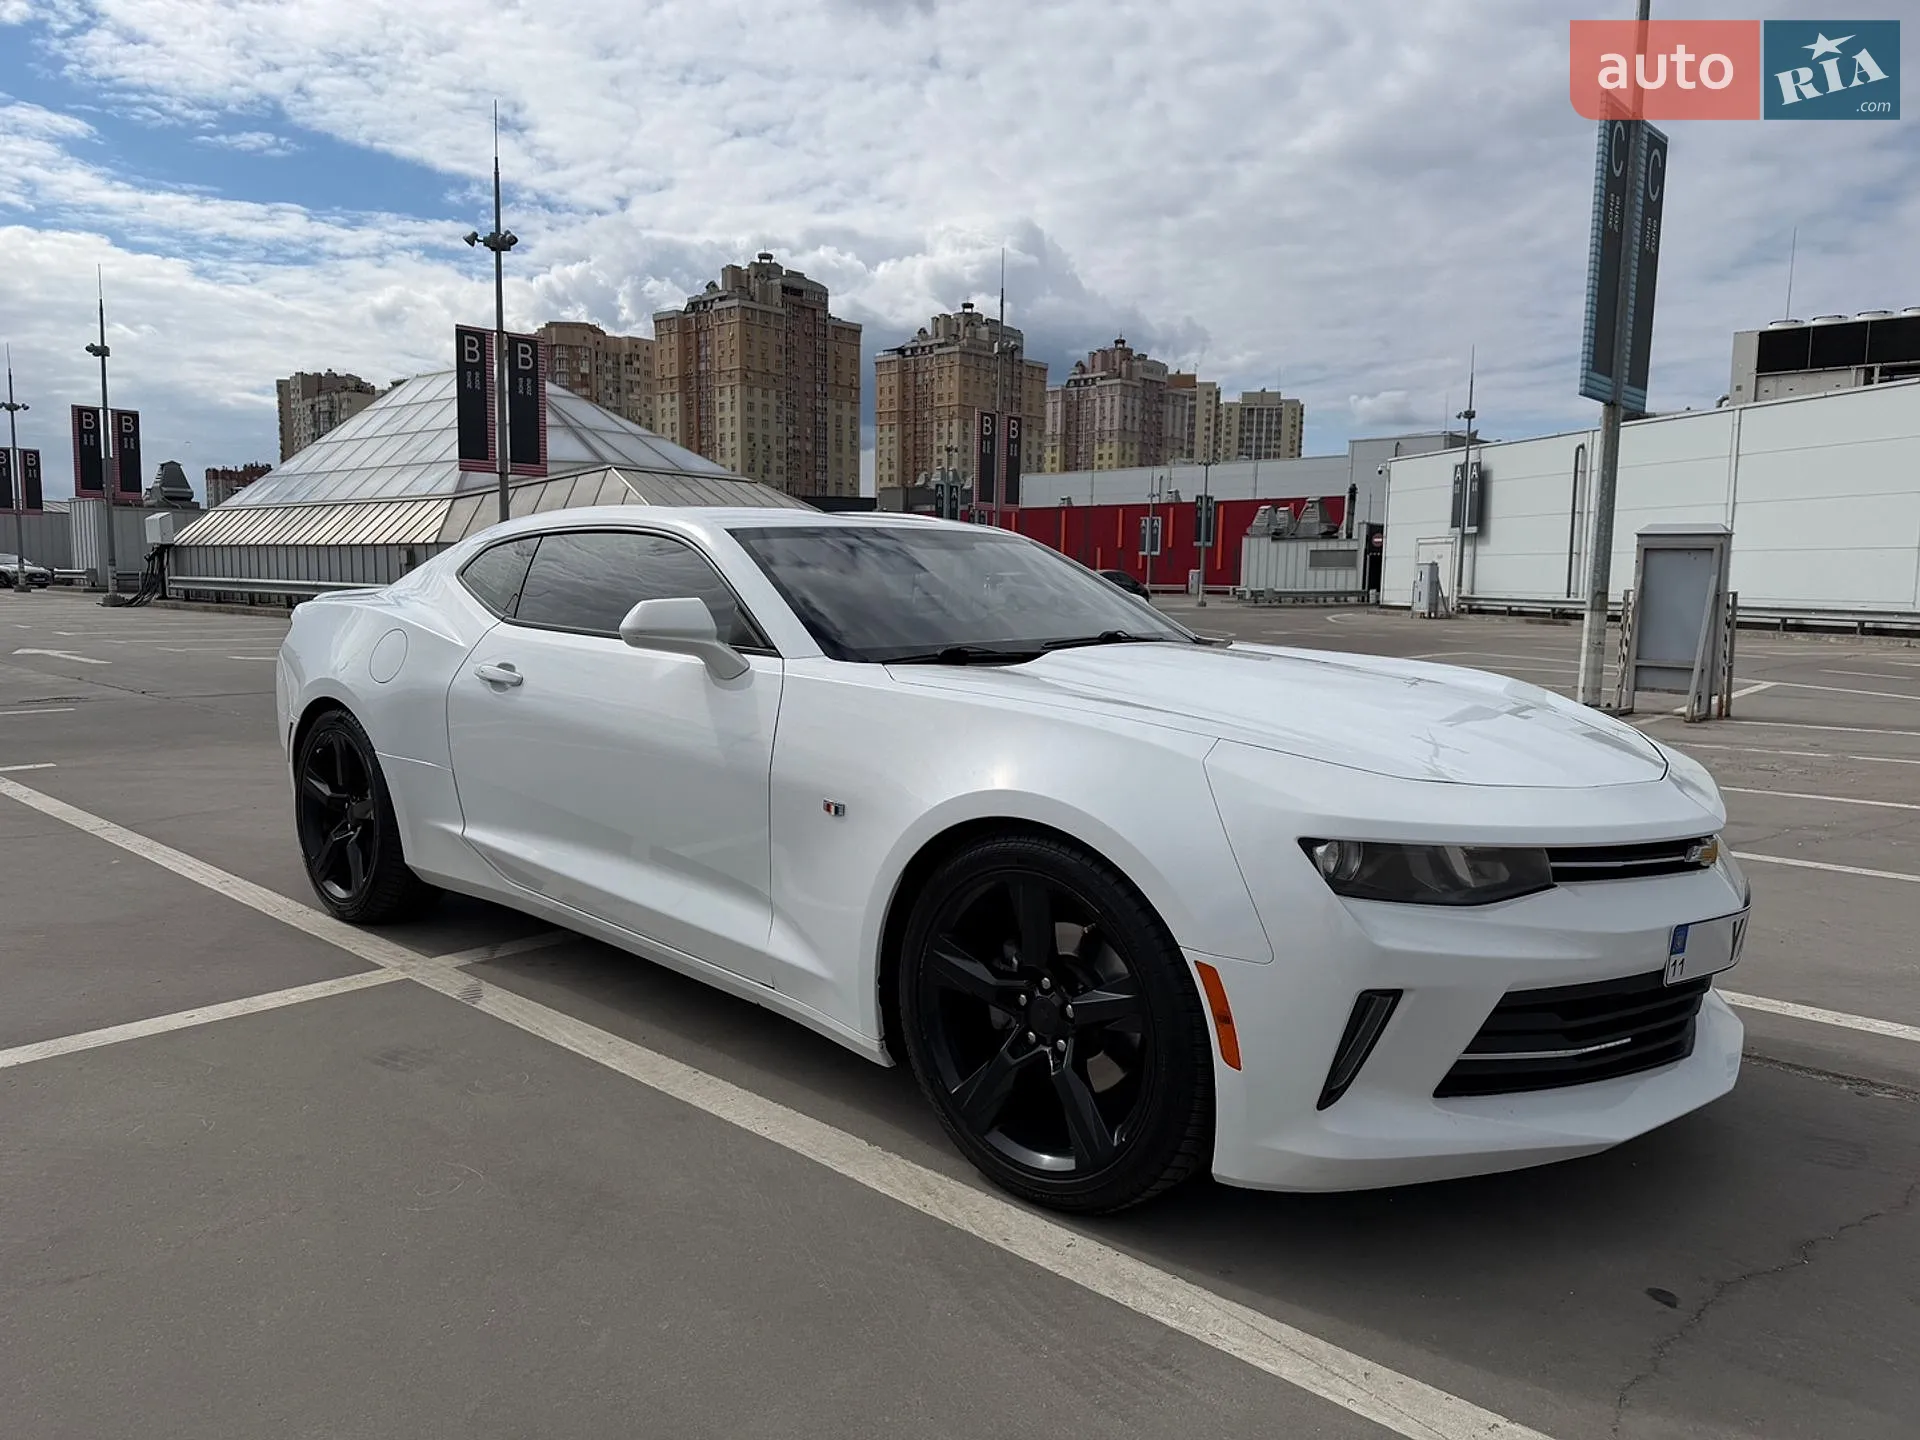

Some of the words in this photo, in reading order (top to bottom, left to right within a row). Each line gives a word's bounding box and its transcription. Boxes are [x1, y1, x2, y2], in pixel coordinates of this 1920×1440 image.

[1612, 121, 1625, 177] C
[1648, 149, 1661, 202] C
[464, 335, 480, 363] B
[517, 342, 534, 370] B
[82, 412, 95, 430] B
[122, 416, 134, 433] B
[983, 416, 992, 435] B
[1010, 420, 1019, 438] B
[26, 453, 36, 466] B
[1455, 465, 1462, 480] A
[1471, 464, 1478, 479] A
[1671, 958, 1685, 977] 11
